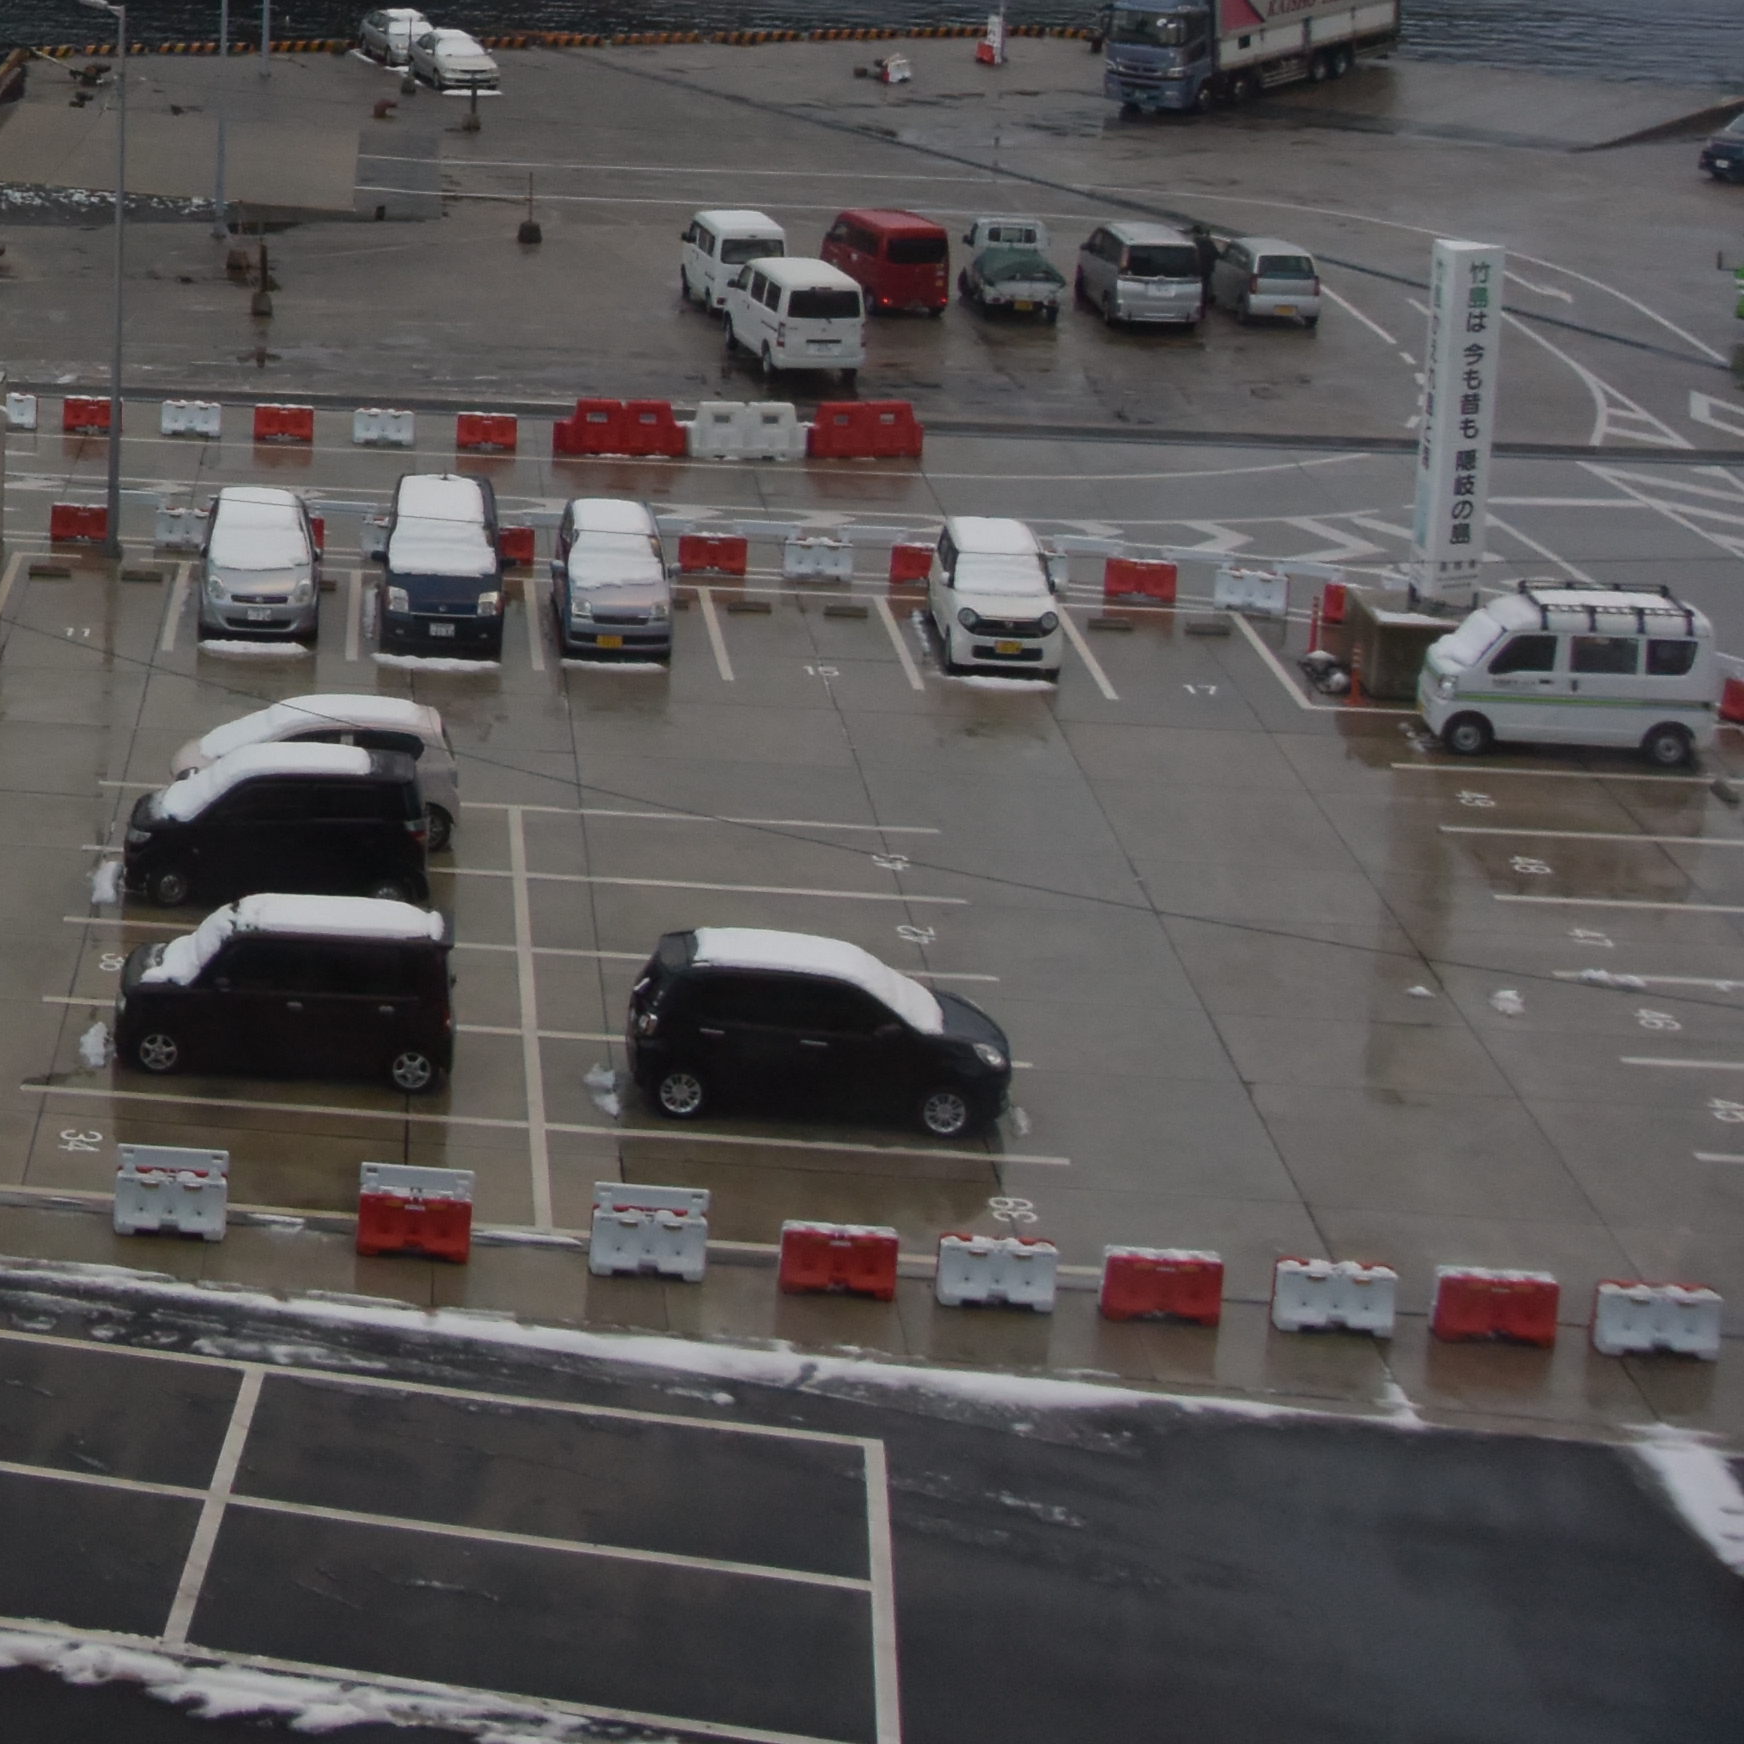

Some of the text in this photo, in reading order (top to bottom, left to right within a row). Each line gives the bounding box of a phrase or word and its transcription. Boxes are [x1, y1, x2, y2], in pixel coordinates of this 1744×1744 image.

[1458, 342, 1485, 440] 今も昔も
[60, 1129, 104, 1153] 34
[989, 1197, 1040, 1226] 39
